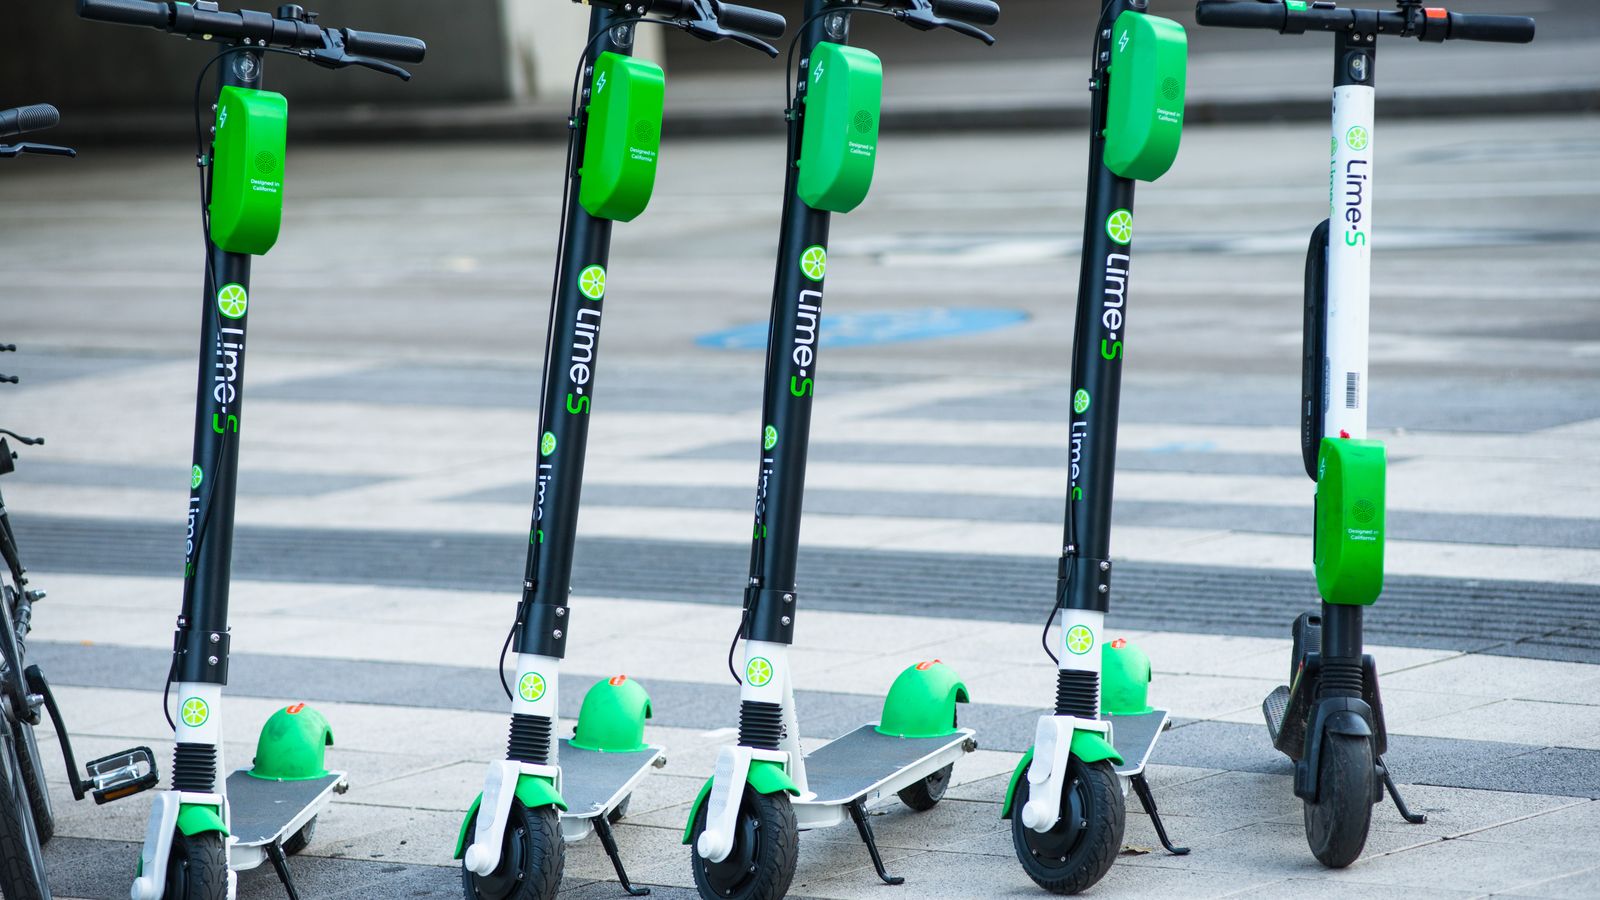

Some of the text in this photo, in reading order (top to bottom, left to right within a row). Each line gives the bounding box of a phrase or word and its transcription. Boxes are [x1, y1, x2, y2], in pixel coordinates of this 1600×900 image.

[1157, 108, 1176, 117] Designed
[1158, 114, 1178, 123] California
[849, 141, 869, 150] Designed
[630, 147, 651, 156] Designed
[850, 148, 871, 157] California
[631, 153, 652, 162] California
[250, 178, 274, 187] Designed
[252, 185, 277, 193] California
